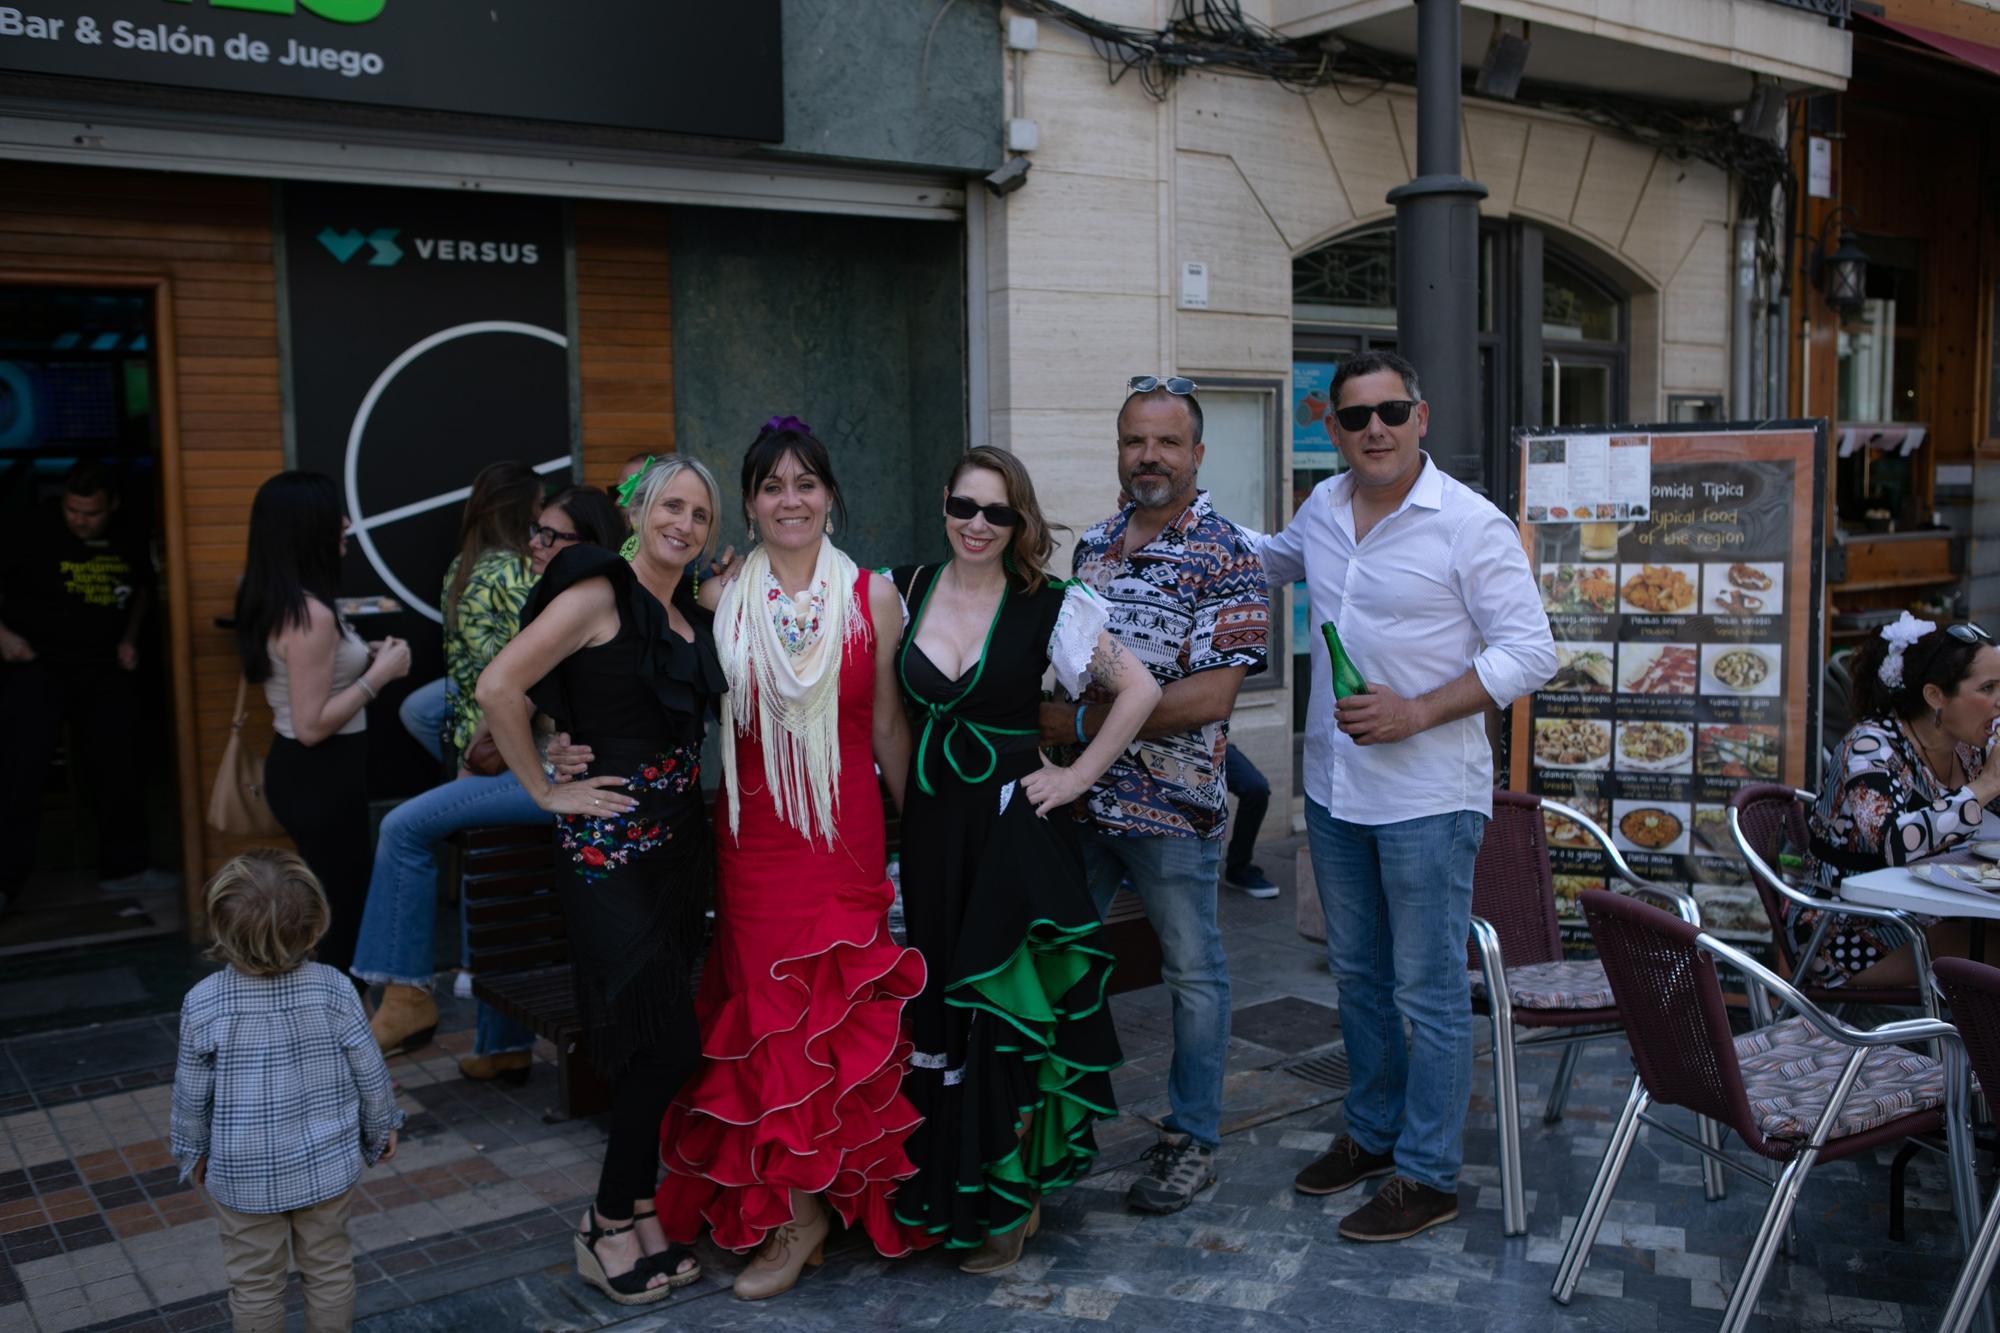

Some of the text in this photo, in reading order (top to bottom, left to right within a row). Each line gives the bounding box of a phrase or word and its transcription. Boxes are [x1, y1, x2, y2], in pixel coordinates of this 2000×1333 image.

[0, 7, 384, 77] Bar & Salón de Juego
[413, 238, 539, 264] VERSUS
[1651, 482, 1694, 500] omida
[1703, 507, 1738, 526] food
[1639, 530, 1745, 552] of the region
